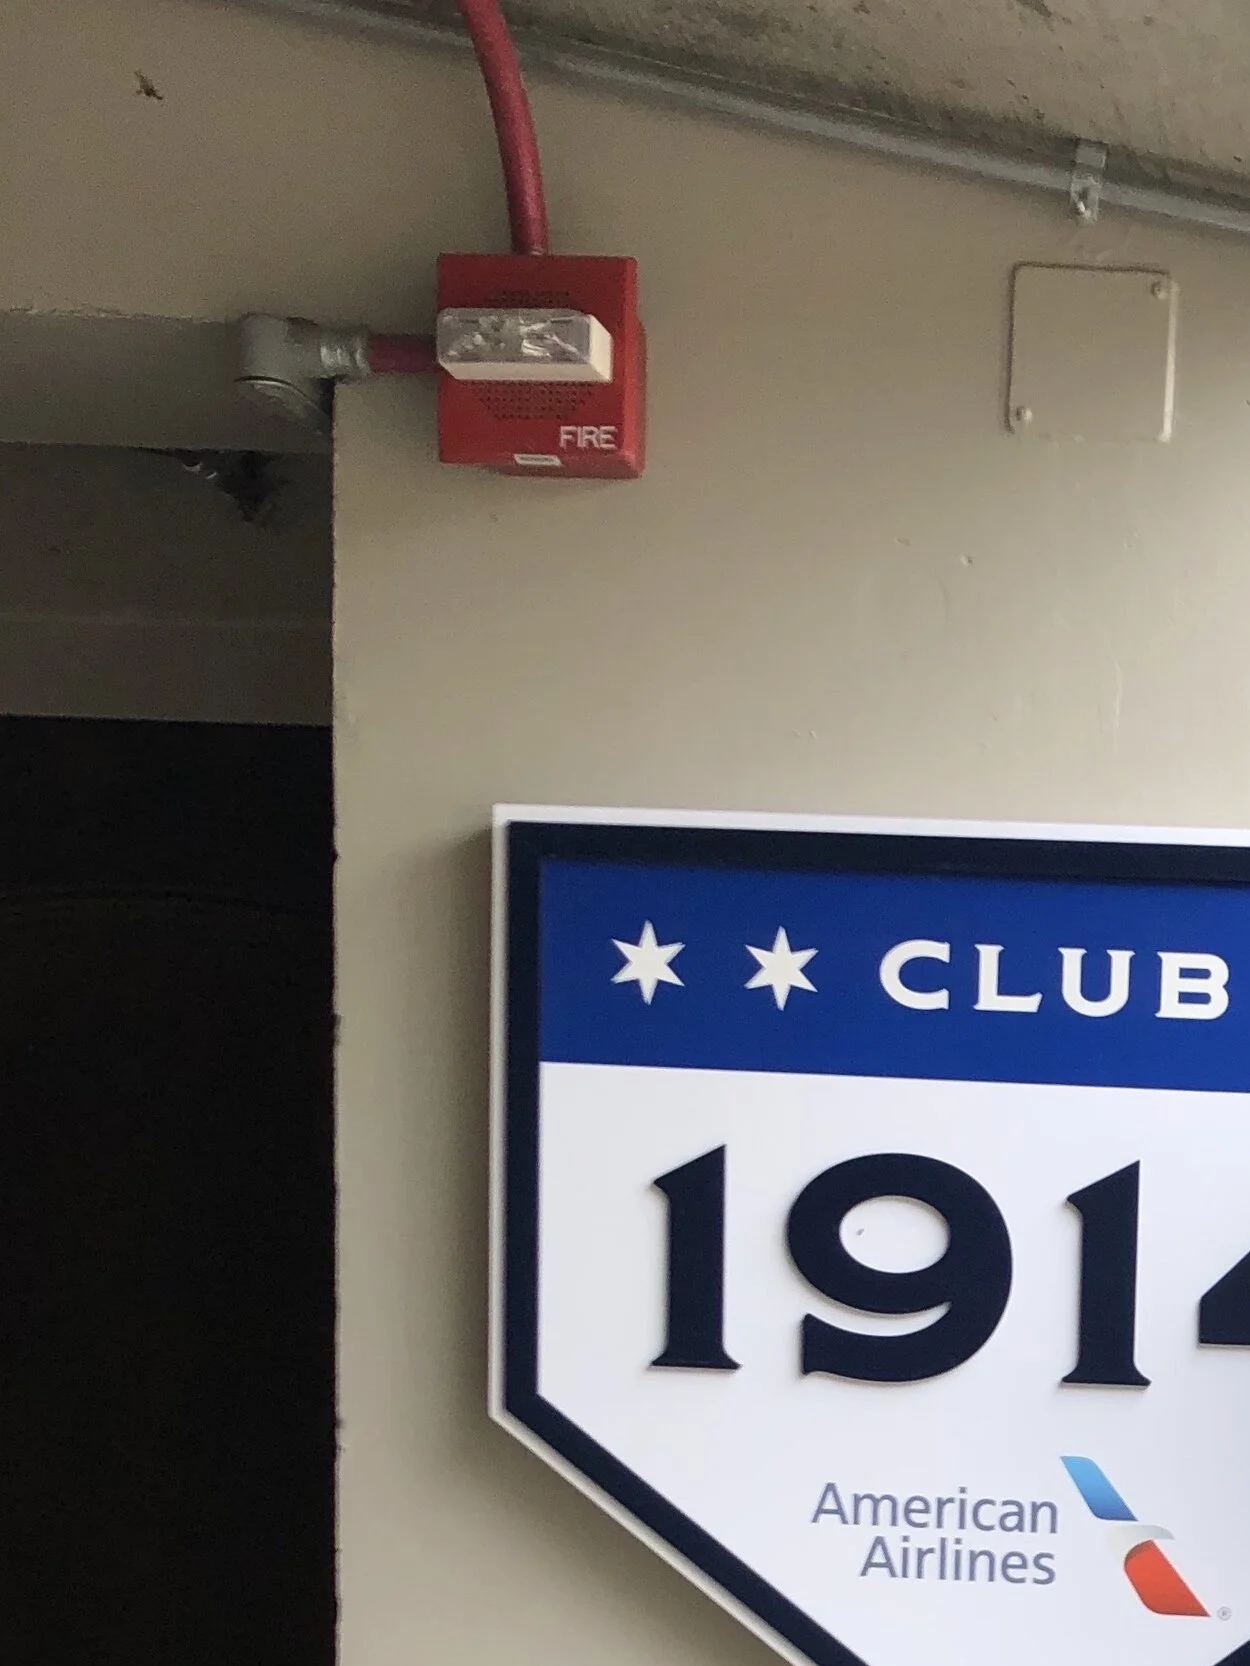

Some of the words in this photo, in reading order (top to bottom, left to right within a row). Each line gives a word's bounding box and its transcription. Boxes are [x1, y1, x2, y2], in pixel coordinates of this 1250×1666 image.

[559, 425, 617, 449] FIRE
[879, 939, 1230, 1020] CLUB
[811, 1482, 1058, 1534] American
[860, 1535, 1056, 1585] Airlines
